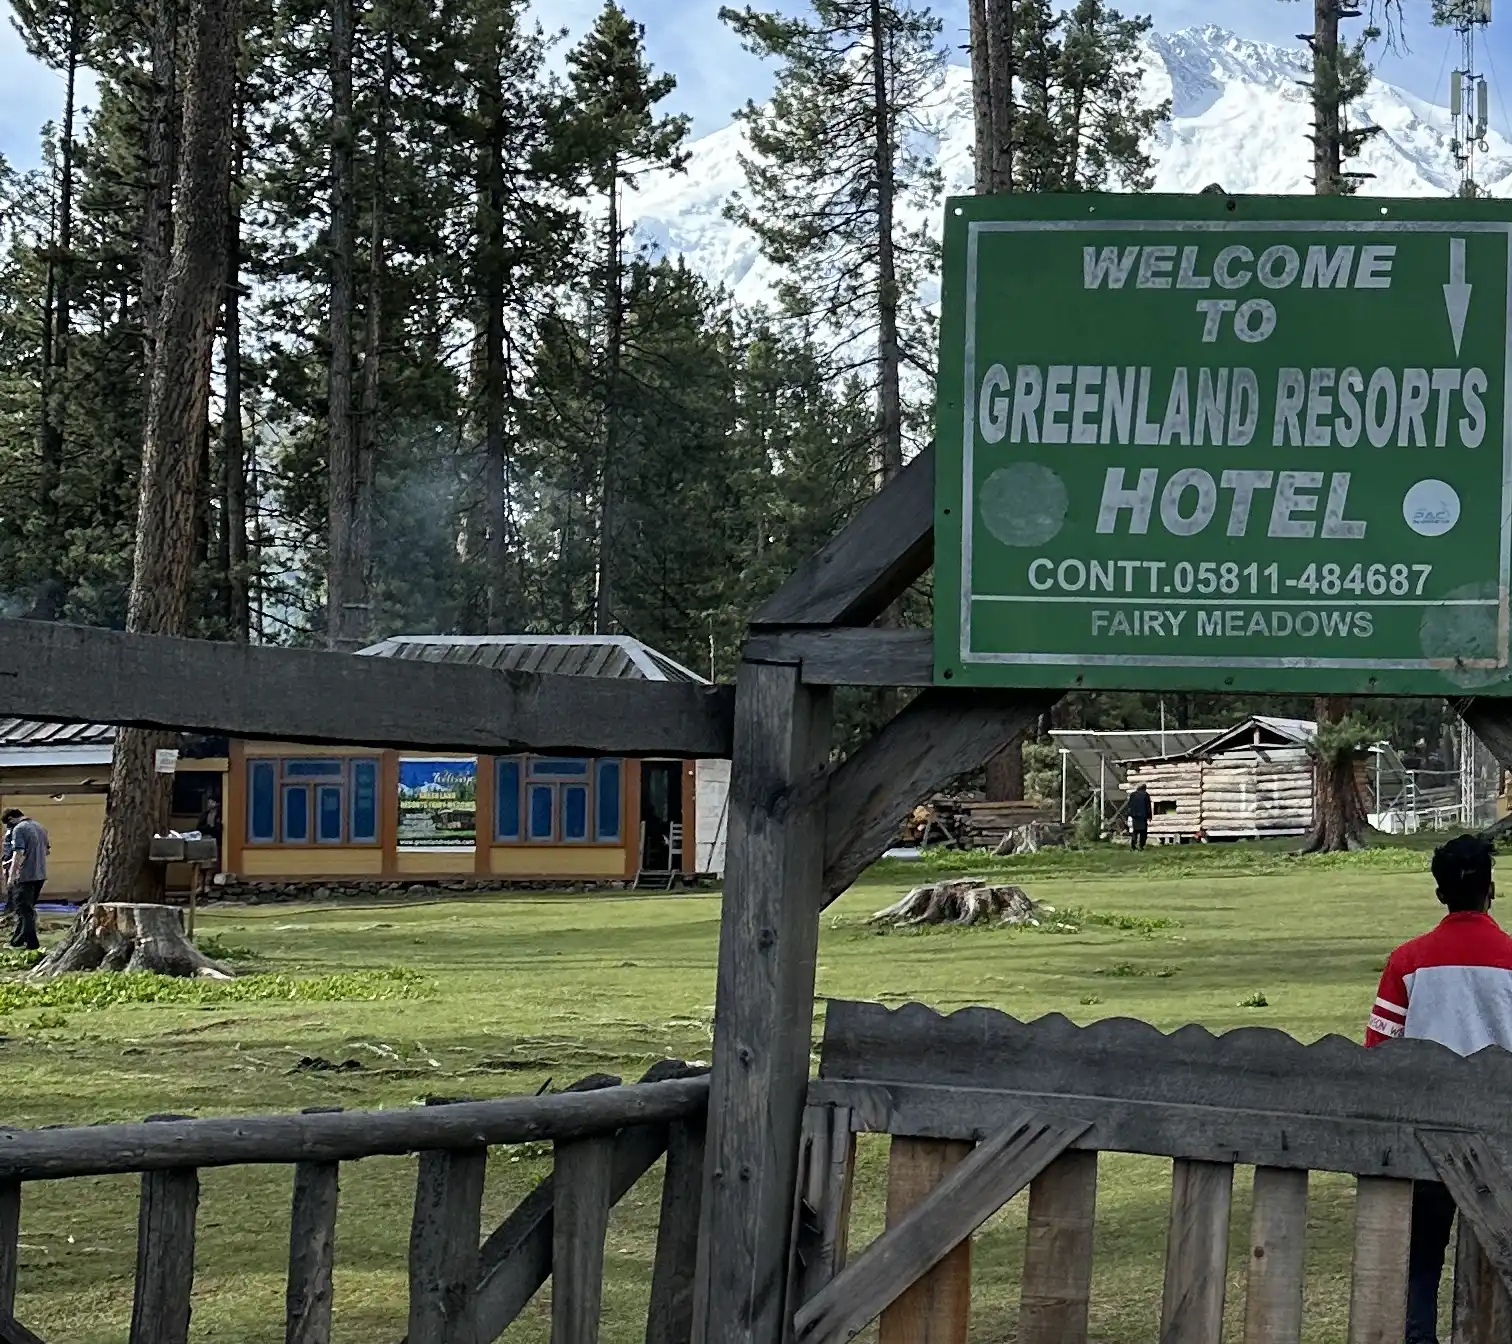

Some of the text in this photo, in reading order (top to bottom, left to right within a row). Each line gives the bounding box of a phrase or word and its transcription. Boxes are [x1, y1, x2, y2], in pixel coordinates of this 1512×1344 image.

[1083, 244, 1397, 289] WELCOME
[1196, 298, 1277, 343] TO
[979, 363, 1488, 449] GREENLAND RESORTS
[1095, 467, 1368, 539] HOTEL
[1027, 558, 1433, 596] CONTT.05811-484687
[1091, 610, 1374, 638] FAIRY MEADOWS
